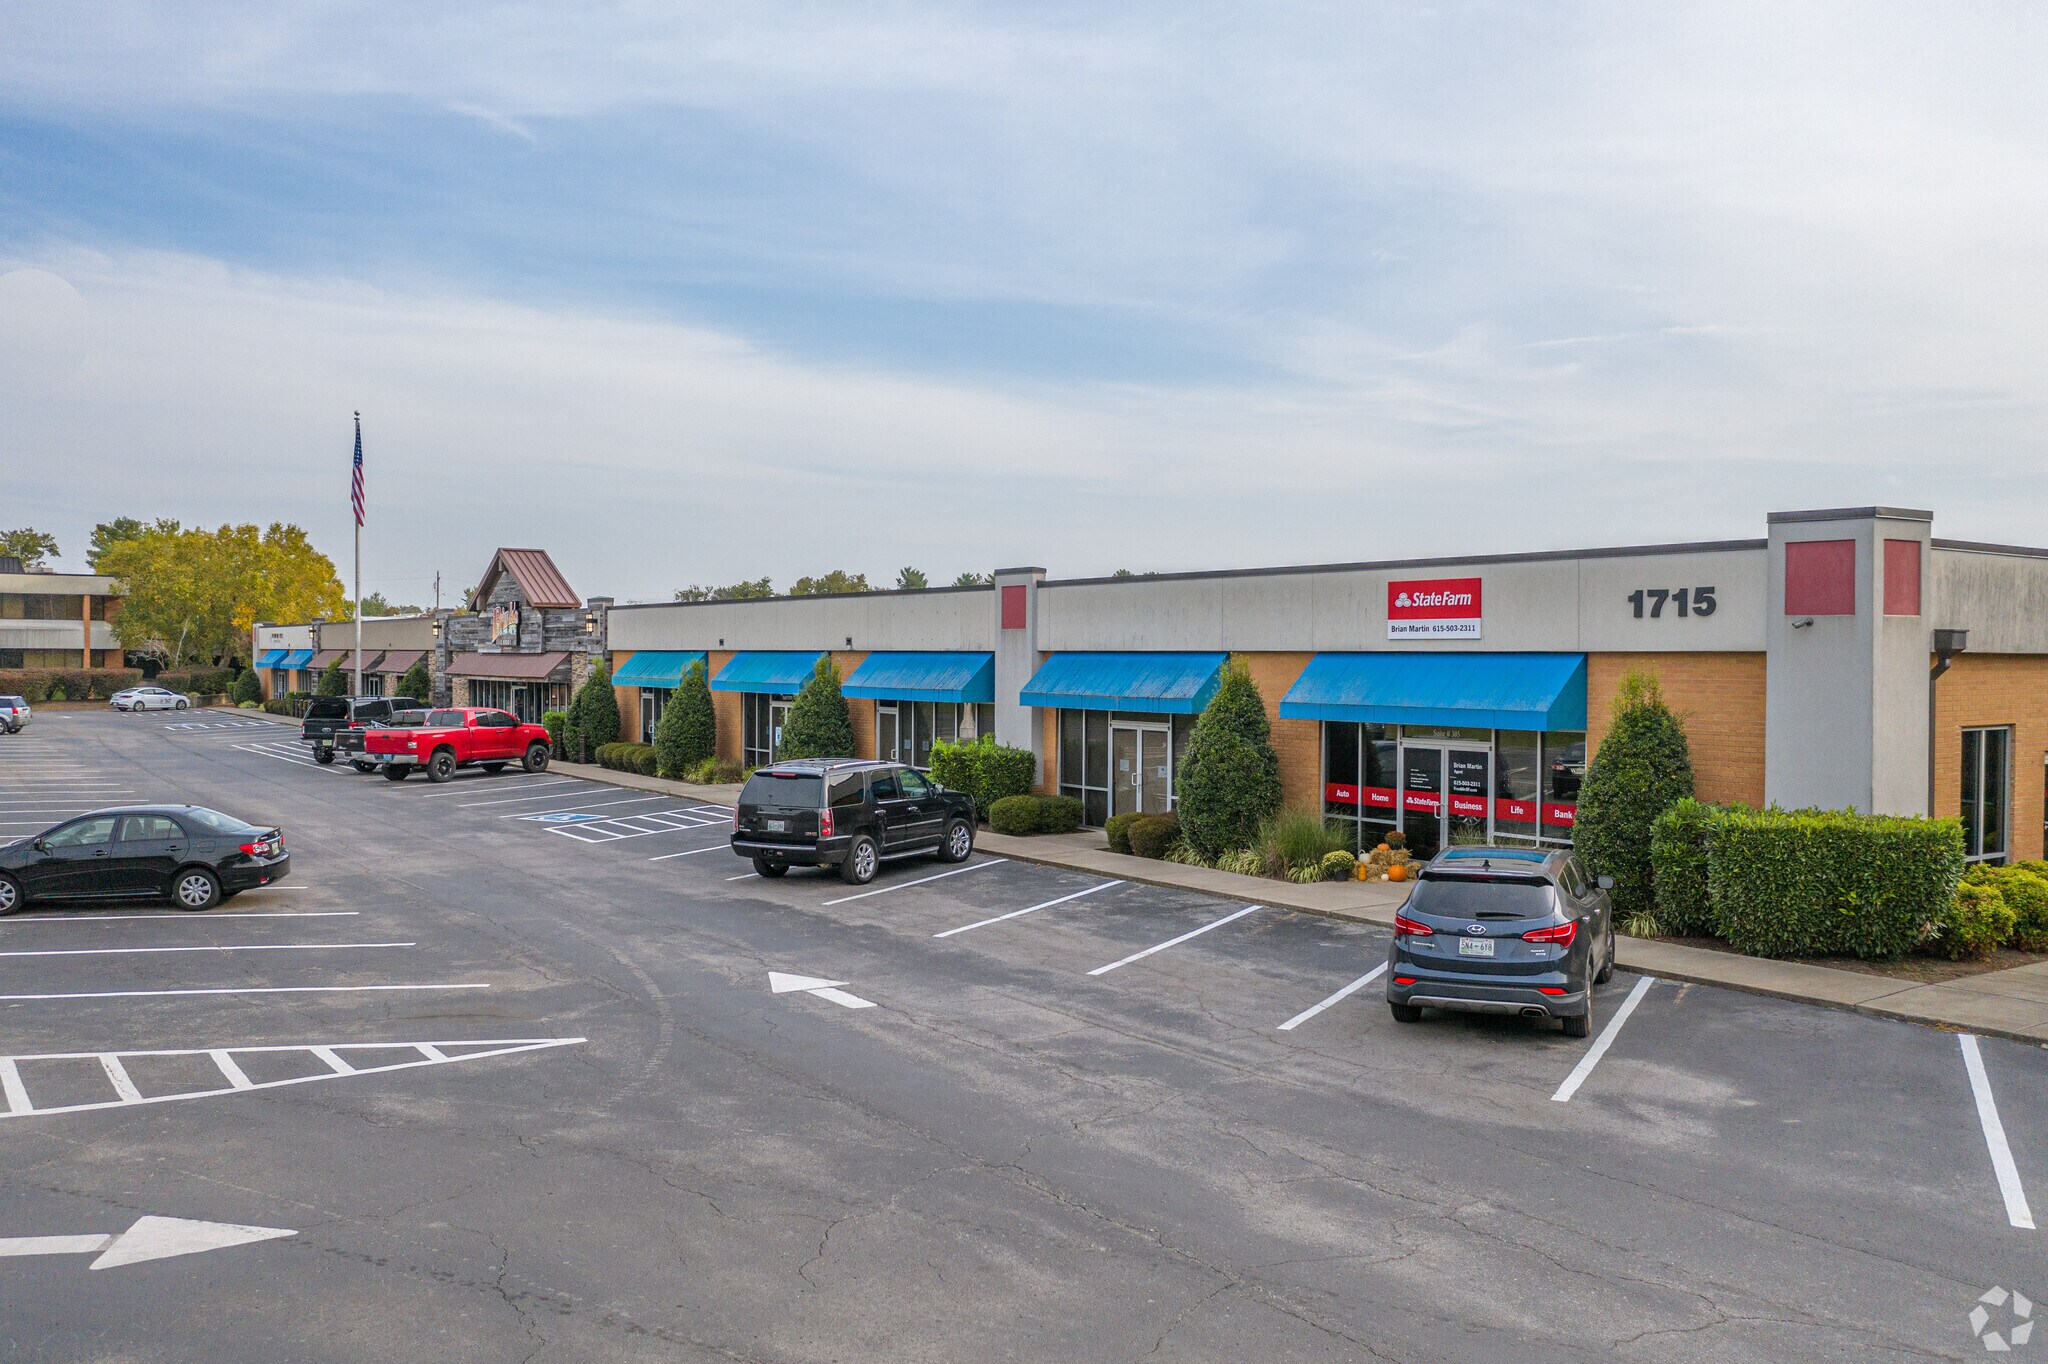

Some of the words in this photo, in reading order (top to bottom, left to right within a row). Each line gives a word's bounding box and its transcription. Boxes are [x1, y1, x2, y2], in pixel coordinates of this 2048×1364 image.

[1627, 586, 1717, 618] 1715
[1391, 625, 1408, 633] Brian
[1408, 624, 1430, 633] Martin
[1432, 624, 1476, 632] 615-503-2311
[1336, 789, 1350, 798] Auto
[1371, 792, 1390, 802] Home
[1454, 801, 1482, 811] Business
[1510, 805, 1524, 815] Life
[1554, 809, 1573, 819] Bank
